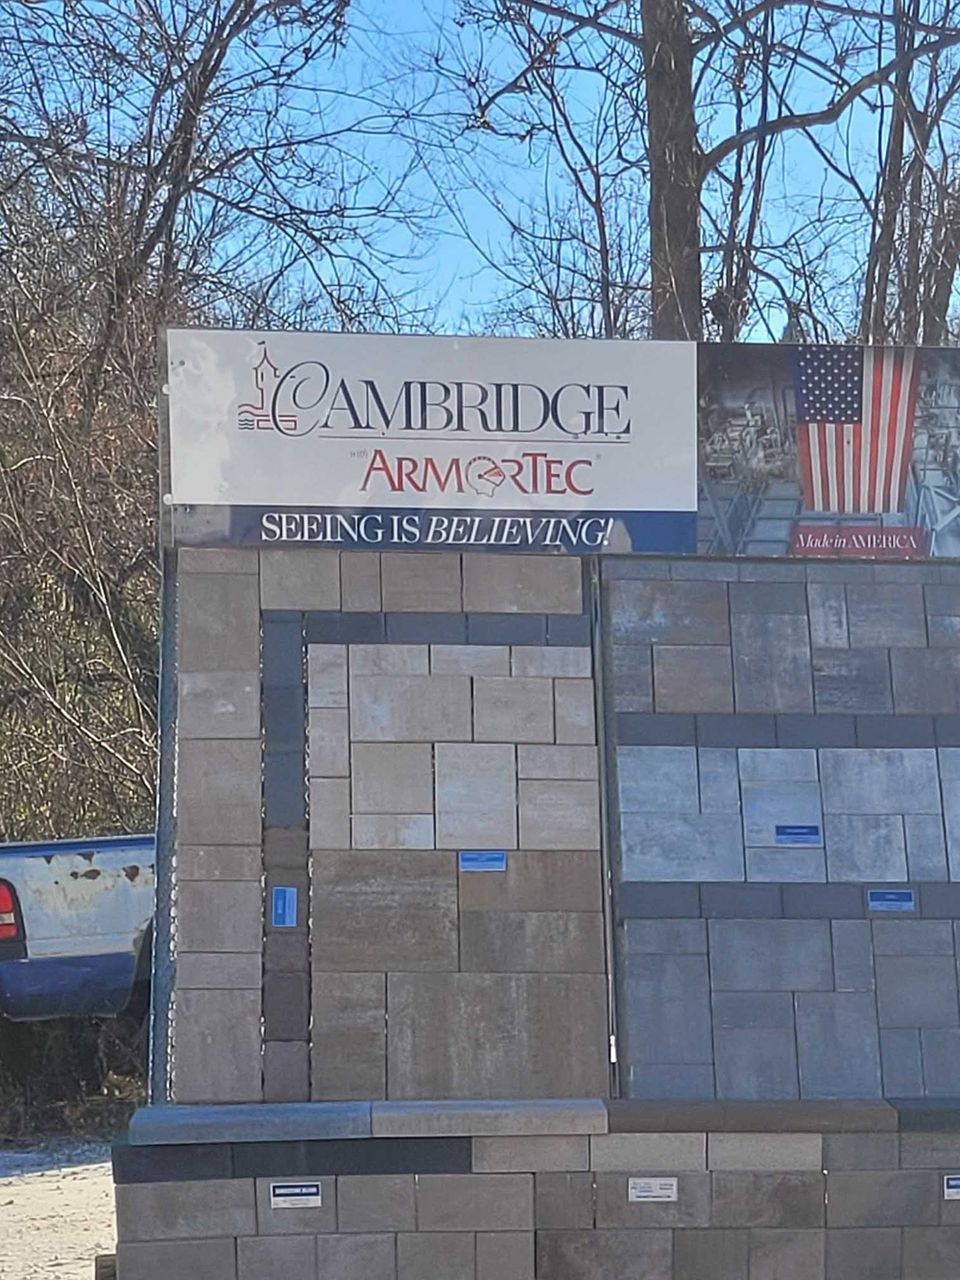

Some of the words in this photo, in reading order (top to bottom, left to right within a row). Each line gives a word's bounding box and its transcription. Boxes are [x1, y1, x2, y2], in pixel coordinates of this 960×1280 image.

[271, 361, 631, 437] CAMBRIDGE
[261, 513, 384, 542] SEEING
[391, 516, 420, 542] IS
[424, 517, 615, 546] BELIEVING!
[796, 533, 832, 548] Made
[833, 534, 847, 548] in
[848, 534, 917, 549] AMERICA
